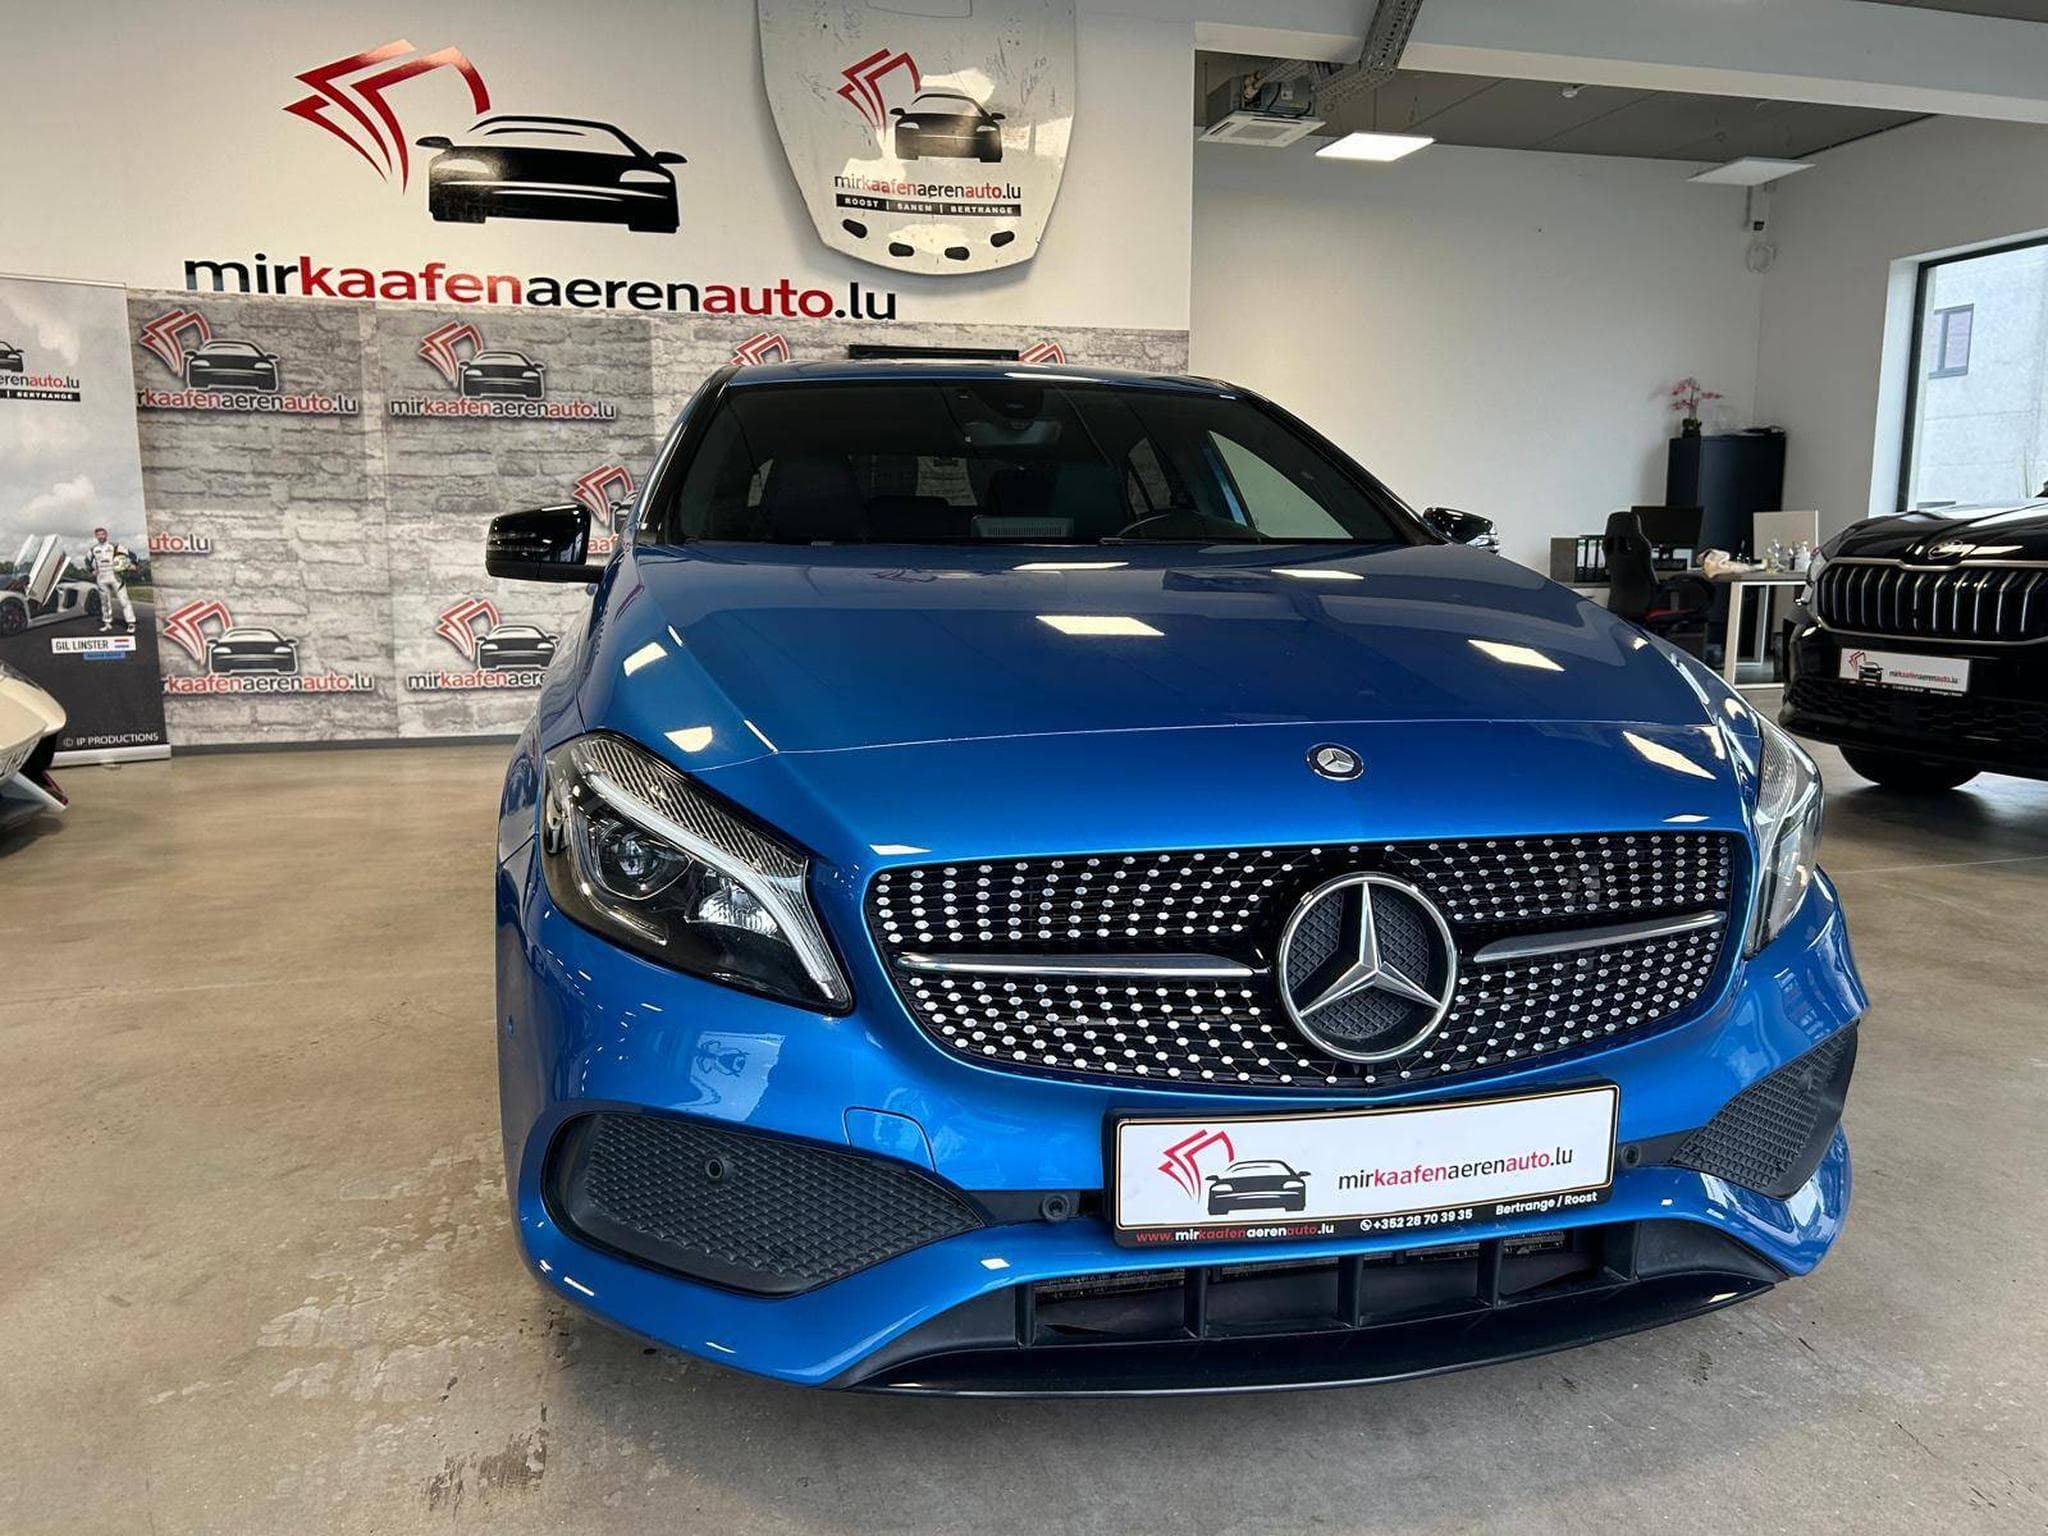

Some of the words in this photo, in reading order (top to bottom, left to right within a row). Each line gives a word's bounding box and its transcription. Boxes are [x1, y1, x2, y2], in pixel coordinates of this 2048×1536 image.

[834, 174, 1021, 200] mirkaafenaerenauto.lu
[844, 197, 880, 209] ROOST
[897, 202, 932, 213] SANEM
[951, 206, 1014, 216] BERTRANGE
[184, 252, 897, 321] mirkaafenaerenauto.lu
[390, 397, 616, 419] mirkaafenaerenauto.lu
[56, 641, 70, 650] GIL
[73, 639, 109, 650] LINSTER
[76, 736, 86, 746] IP
[88, 732, 159, 745] PRODUCTIONS
[1338, 1147, 1574, 1190] mirkaafenaerenauto.lu
[1373, 1217, 1404, 1230] +352
[1406, 1215, 1421, 1227] 28
[1424, 1213, 1438, 1225] 70
[1441, 1211, 1456, 1223] 39
[1457, 1209, 1473, 1220] 35
[1495, 1200, 1556, 1216] Bertrange
[1564, 1190, 1598, 1206] Roost
